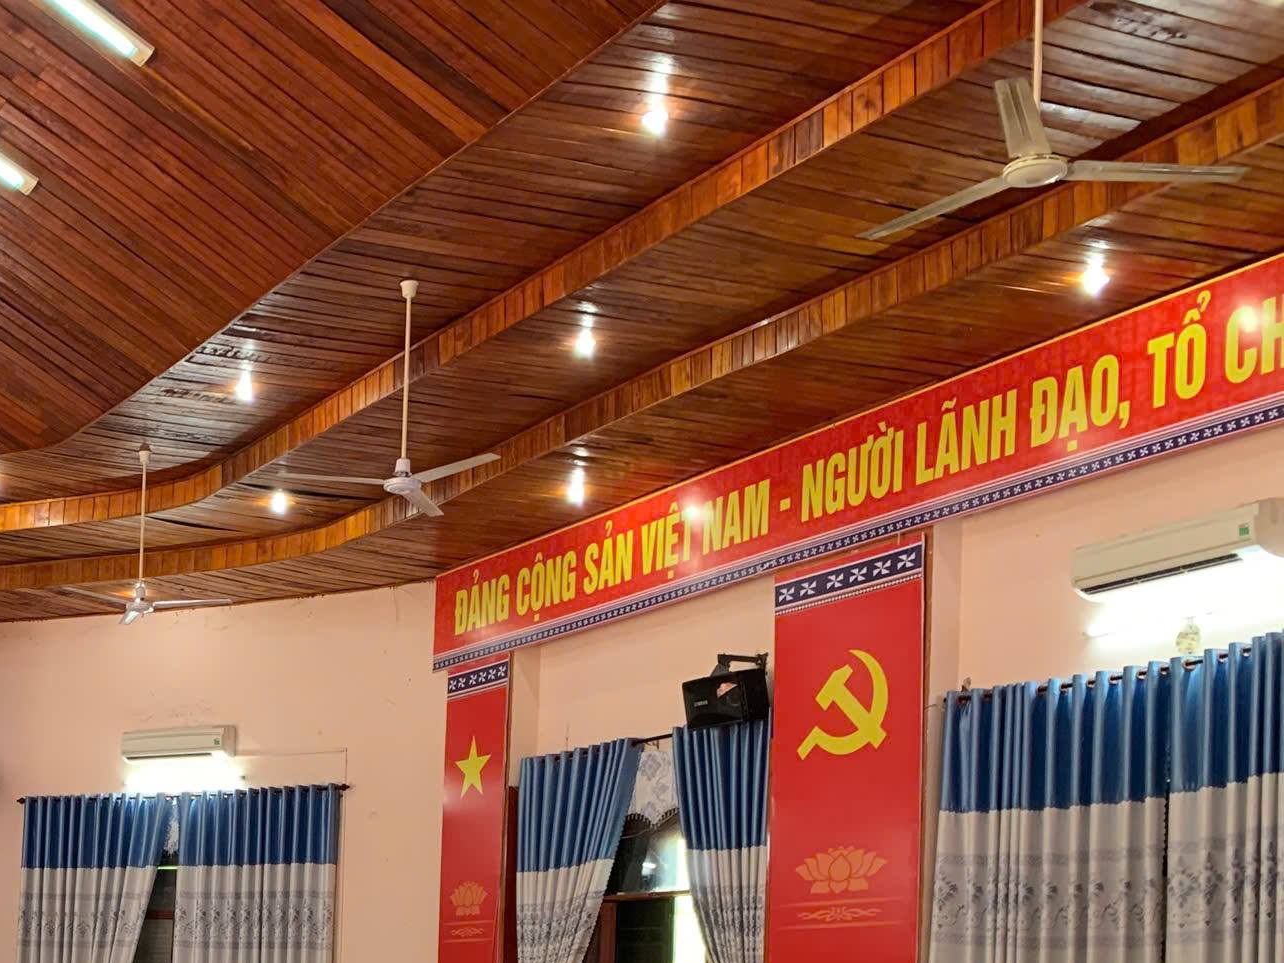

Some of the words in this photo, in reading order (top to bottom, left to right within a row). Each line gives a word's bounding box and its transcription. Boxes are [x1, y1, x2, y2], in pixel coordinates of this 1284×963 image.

[454, 568, 510, 636] ĐẢNG
[516, 551, 577, 621] CỘNG
[583, 520, 634, 595] SẢN
[641, 502, 697, 579] VIỆT
[702, 478, 770, 556] NAM
[801, 421, 904, 523] NGƯỜI
[916, 388, 1017, 486] LÃNH
[1030, 354, 1131, 452] ĐẠO,
[1147, 290, 1211, 409] TỔ
